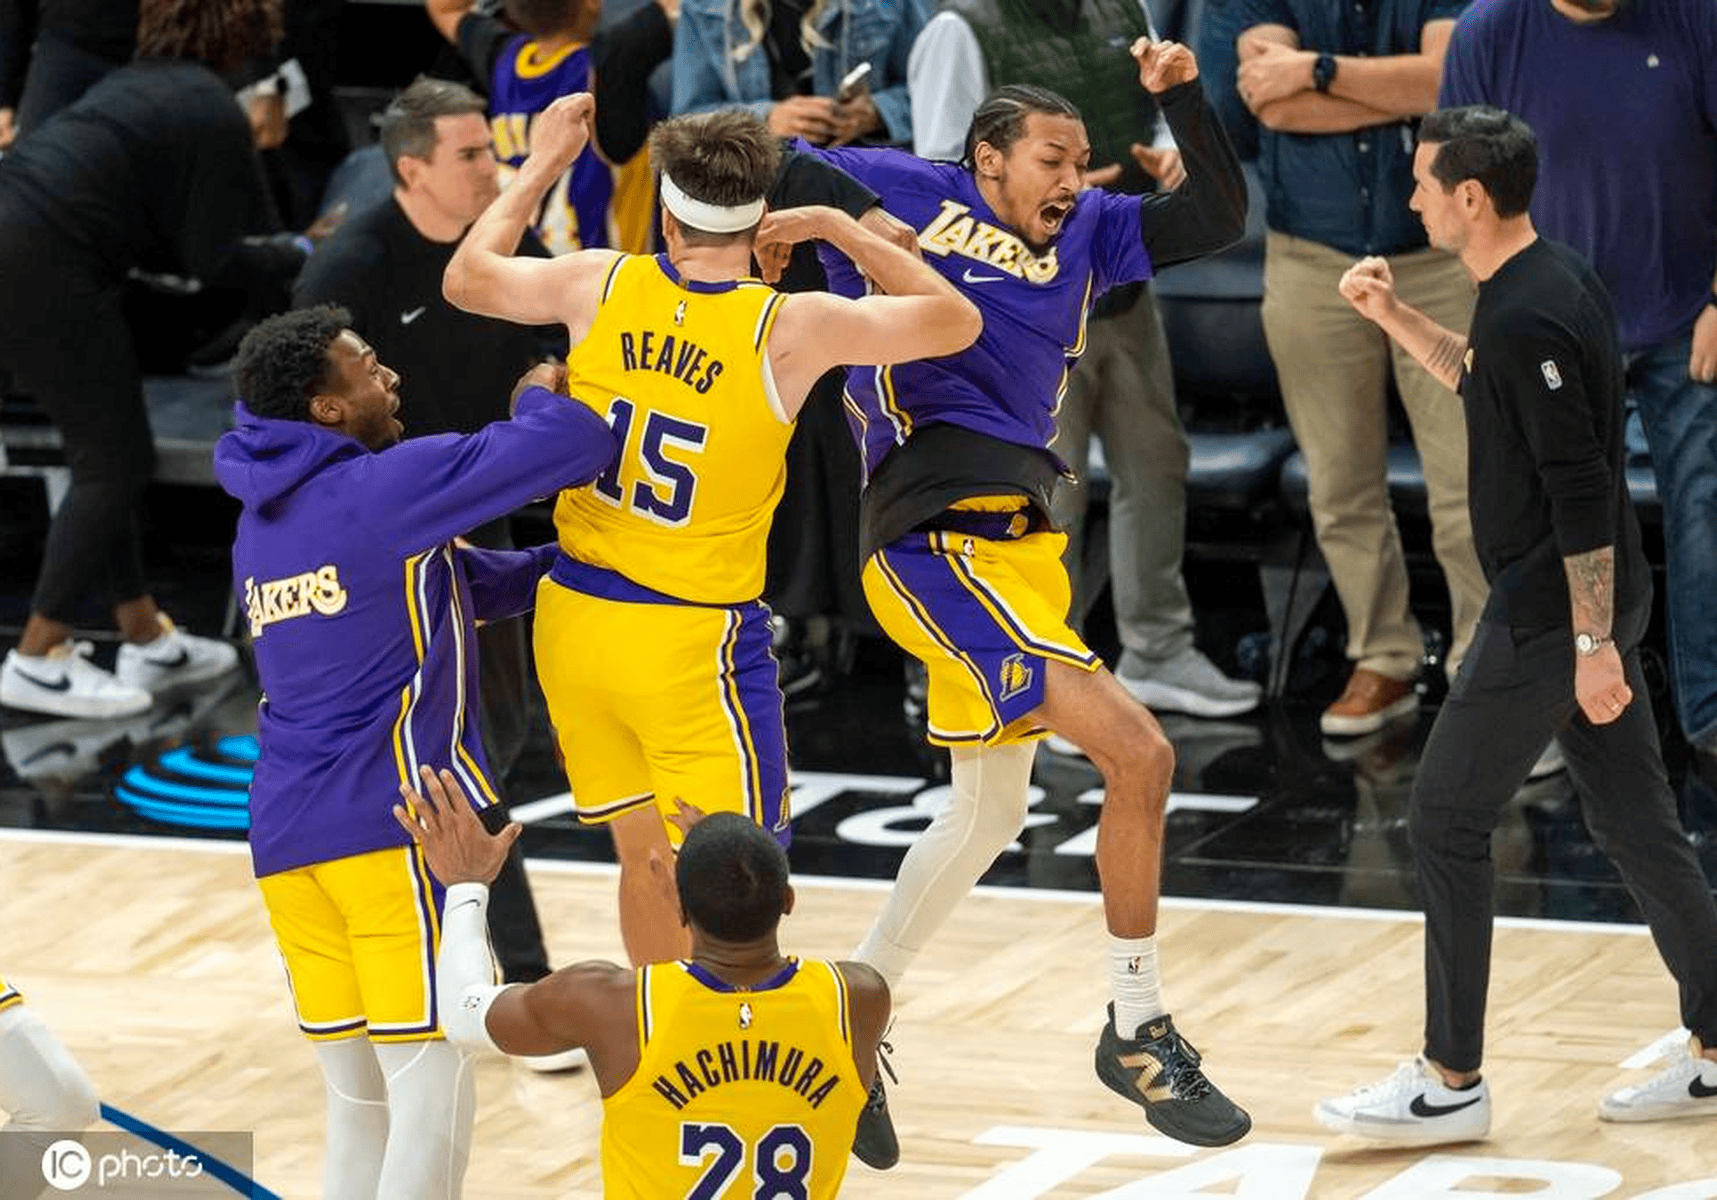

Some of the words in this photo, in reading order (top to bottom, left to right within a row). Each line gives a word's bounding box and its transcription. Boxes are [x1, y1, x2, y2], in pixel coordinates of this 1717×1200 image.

[620, 330, 725, 395] REAVES
[593, 396, 710, 529] 15
[509, 770, 1260, 857] T&T
[651, 1039, 841, 1111] HACHIMURA
[677, 1120, 815, 1200] 28
[953, 1125, 1717, 1200] TAR
